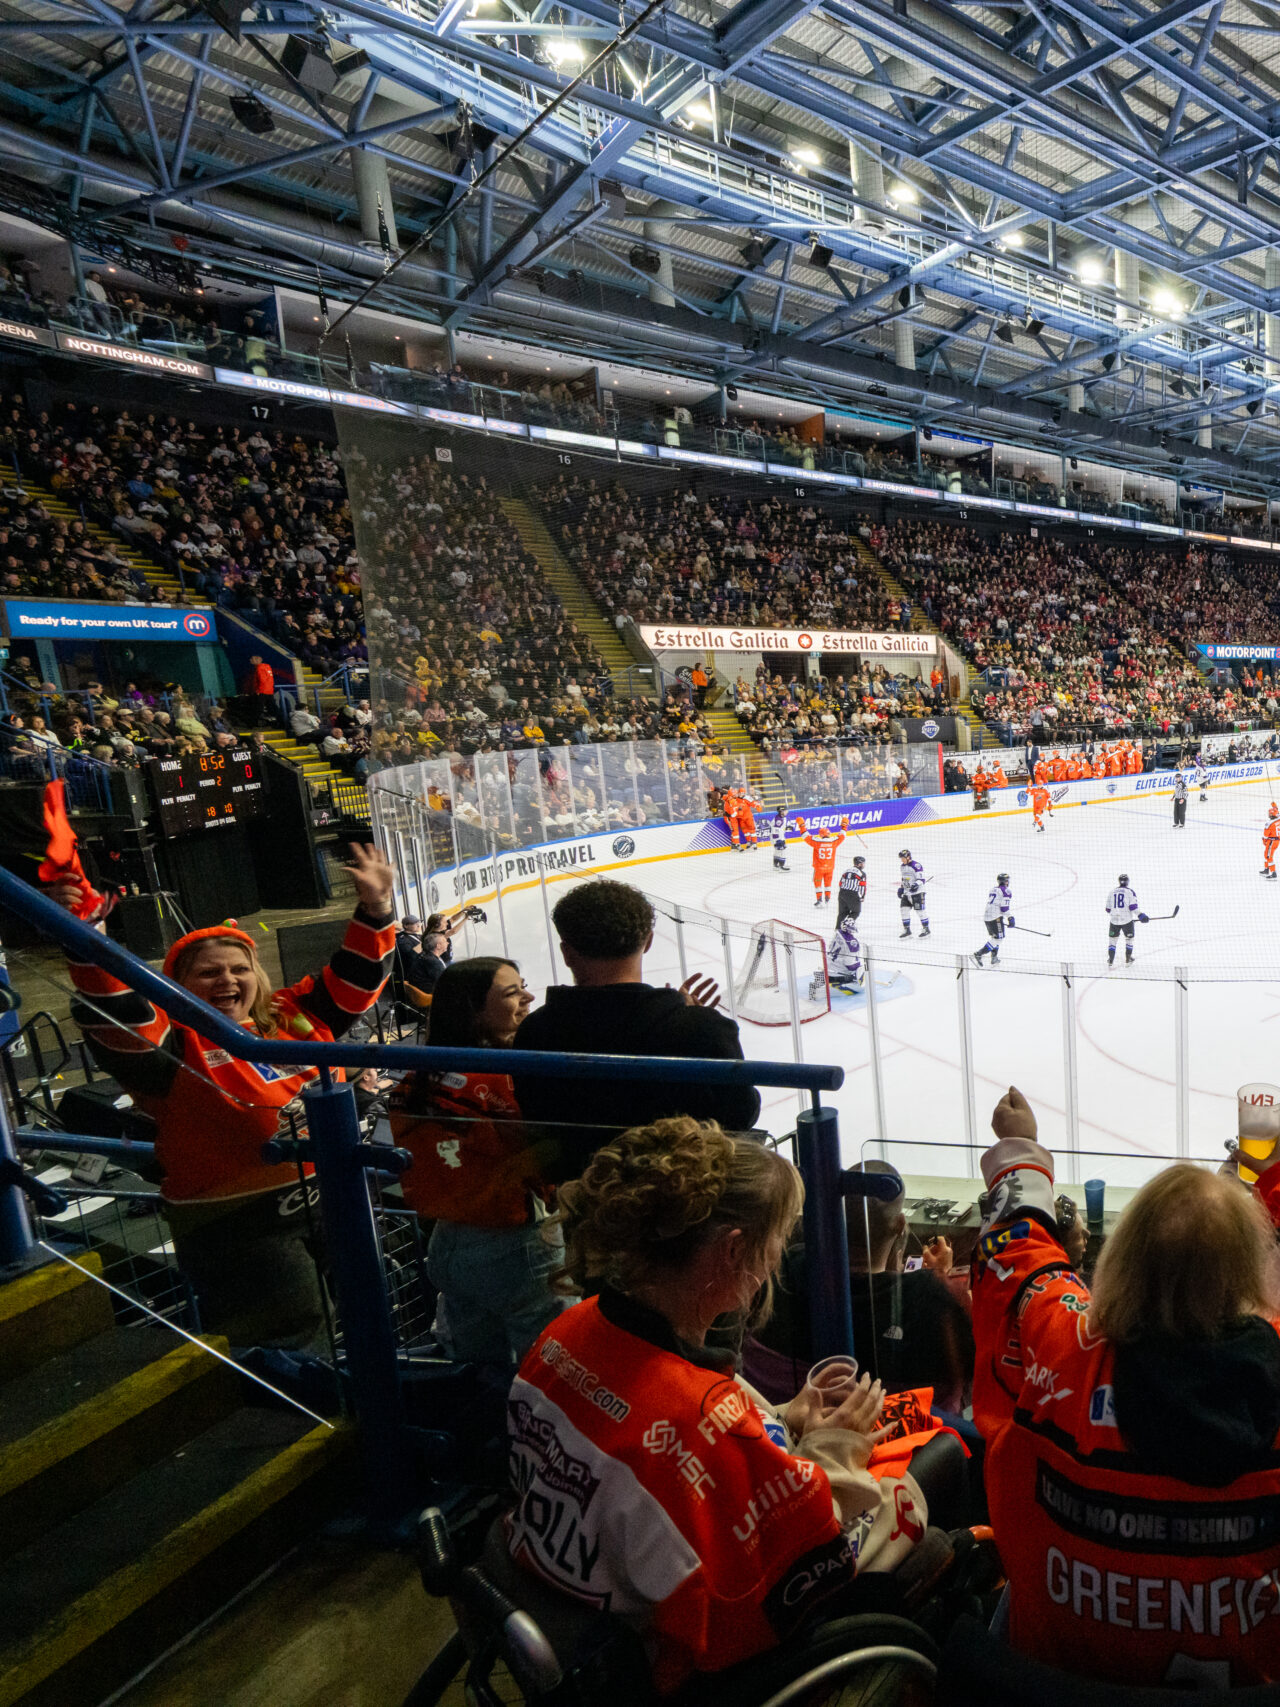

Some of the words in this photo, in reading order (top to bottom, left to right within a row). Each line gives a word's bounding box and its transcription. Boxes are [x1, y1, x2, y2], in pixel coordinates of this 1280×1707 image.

[67, 337, 199, 375] NOTTINGHAM.COM
[256, 378, 345, 402] MOTORPOINT
[251, 406, 270, 420] 17
[558, 454, 571, 465] 16
[795, 487, 805, 497] 16
[959, 511, 968, 519] 15
[19, 615, 59, 627] Ready
[60, 616, 79, 627] for
[80, 619, 106, 628] your
[107, 619, 132, 628] own
[132, 619, 150, 628] UK
[150, 621, 178, 629] tour?
[654, 630, 725, 648] Estrella
[729, 631, 789, 649] Galicia
[822, 634, 879, 651] Estrella
[881, 635, 930, 652] Galicia
[1216, 646, 1276, 659] MOTORPOINT
[200, 755, 226, 772] 8:52
[232, 751, 252, 762] GUEST
[244, 764, 253, 779] 0
[1135, 778, 1157, 791] ELITE
[1220, 769, 1245, 781] FINALS
[1245, 766, 1264, 777] 2026
[179, 776, 184, 789] 1
[199, 778, 216, 787] PERIOD
[216, 776, 222, 787] 2
[850, 810, 883, 825] CLAN
[1113, 893, 1125, 909] 18
[1085, 1507, 1117, 1535] NO
[1119, 1513, 1168, 1540] ONE
[1170, 1515, 1256, 1544] BEHIND
